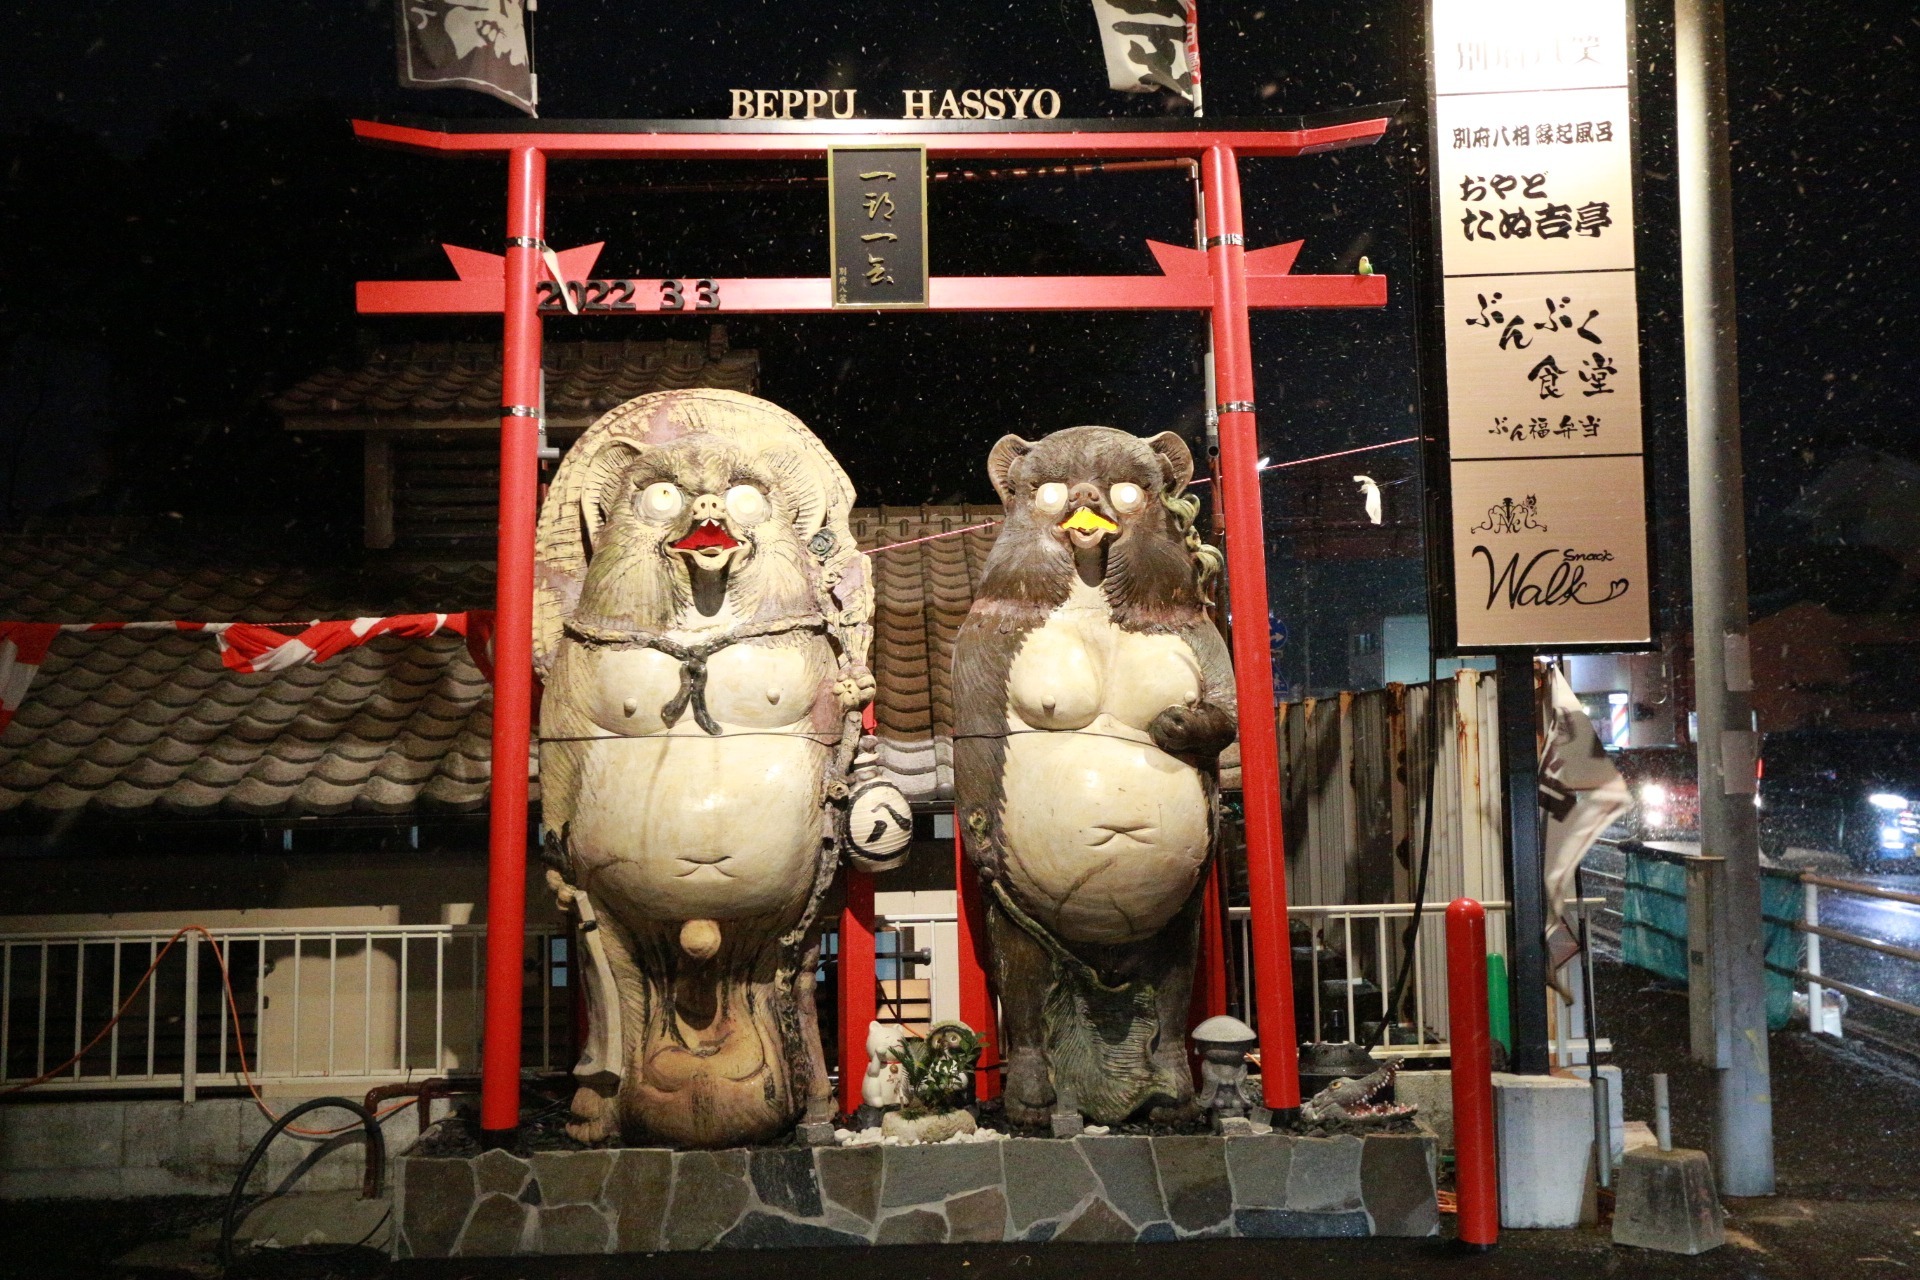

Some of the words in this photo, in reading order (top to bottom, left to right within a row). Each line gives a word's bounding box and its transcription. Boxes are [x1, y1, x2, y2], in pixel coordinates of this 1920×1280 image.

[728, 88, 857, 119] BEPPU
[902, 88, 1061, 120] HASSYO
[1452, 124, 1531, 149] 別府八相
[1535, 120, 1614, 145] 縁起風呂
[1459, 171, 1549, 202] おやど
[1460, 201, 1613, 242] たぬ吉亭
[536, 279, 636, 311] 2022
[1465, 291, 1603, 351] ぶんぶく
[1527, 352, 1619, 400] 食堂
[1488, 415, 1602, 441] ぶん福弁当
[1563, 548, 1615, 562] Snack
[1471, 545, 1602, 611] Walk
